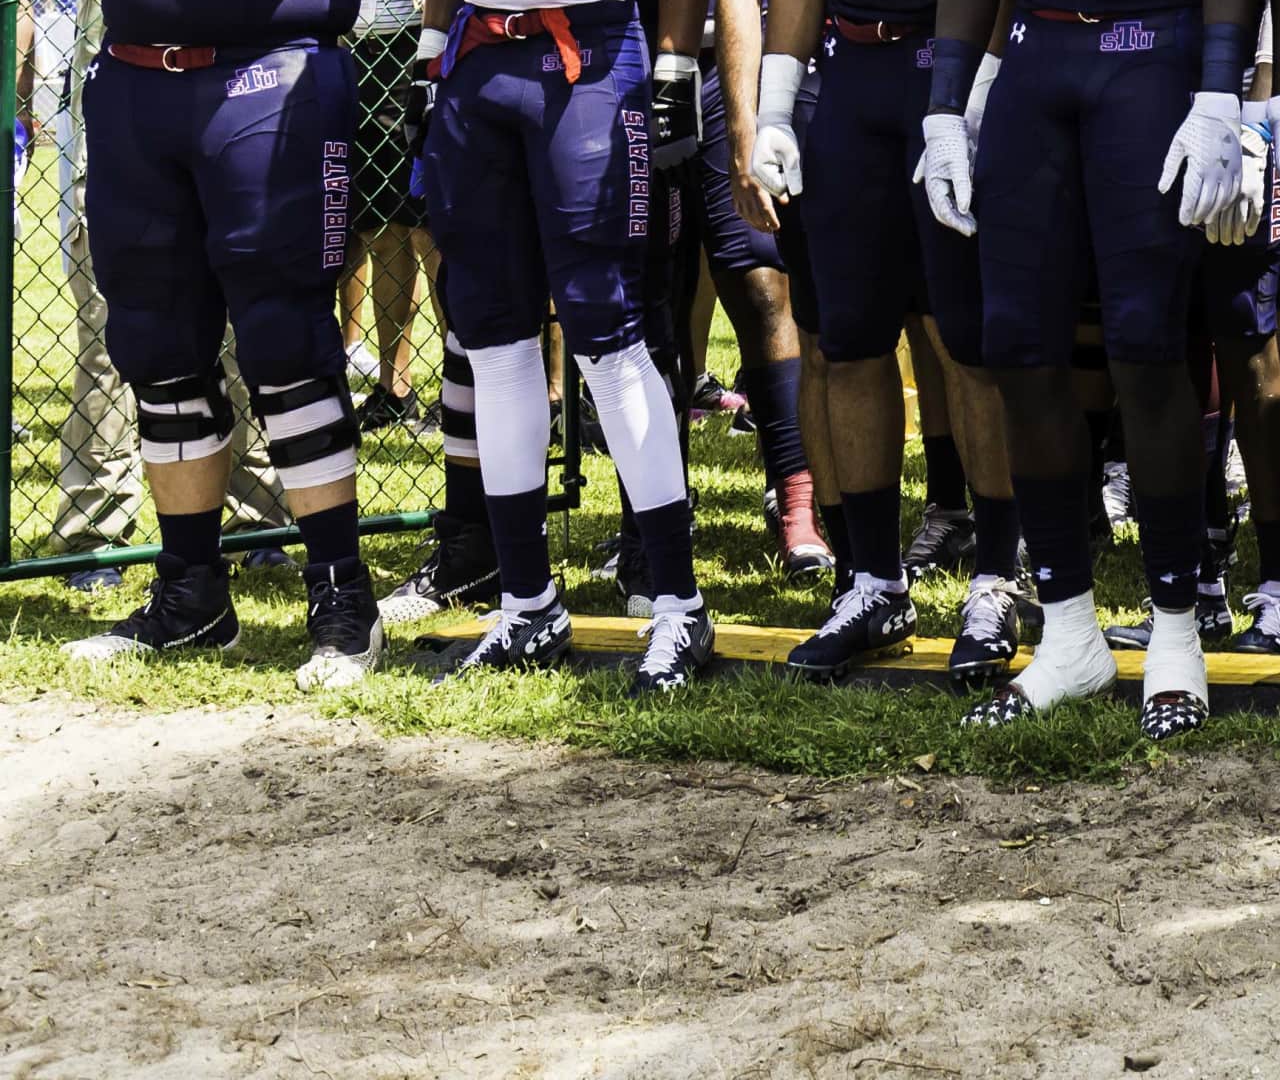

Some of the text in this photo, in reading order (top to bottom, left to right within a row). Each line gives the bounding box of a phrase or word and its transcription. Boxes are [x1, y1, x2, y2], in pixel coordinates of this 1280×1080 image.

[1099, 21, 1155, 52] STU
[323, 140, 350, 269] BOBCATS
[621, 109, 650, 238] BOBCATS
[163, 632, 196, 649] UNDER
